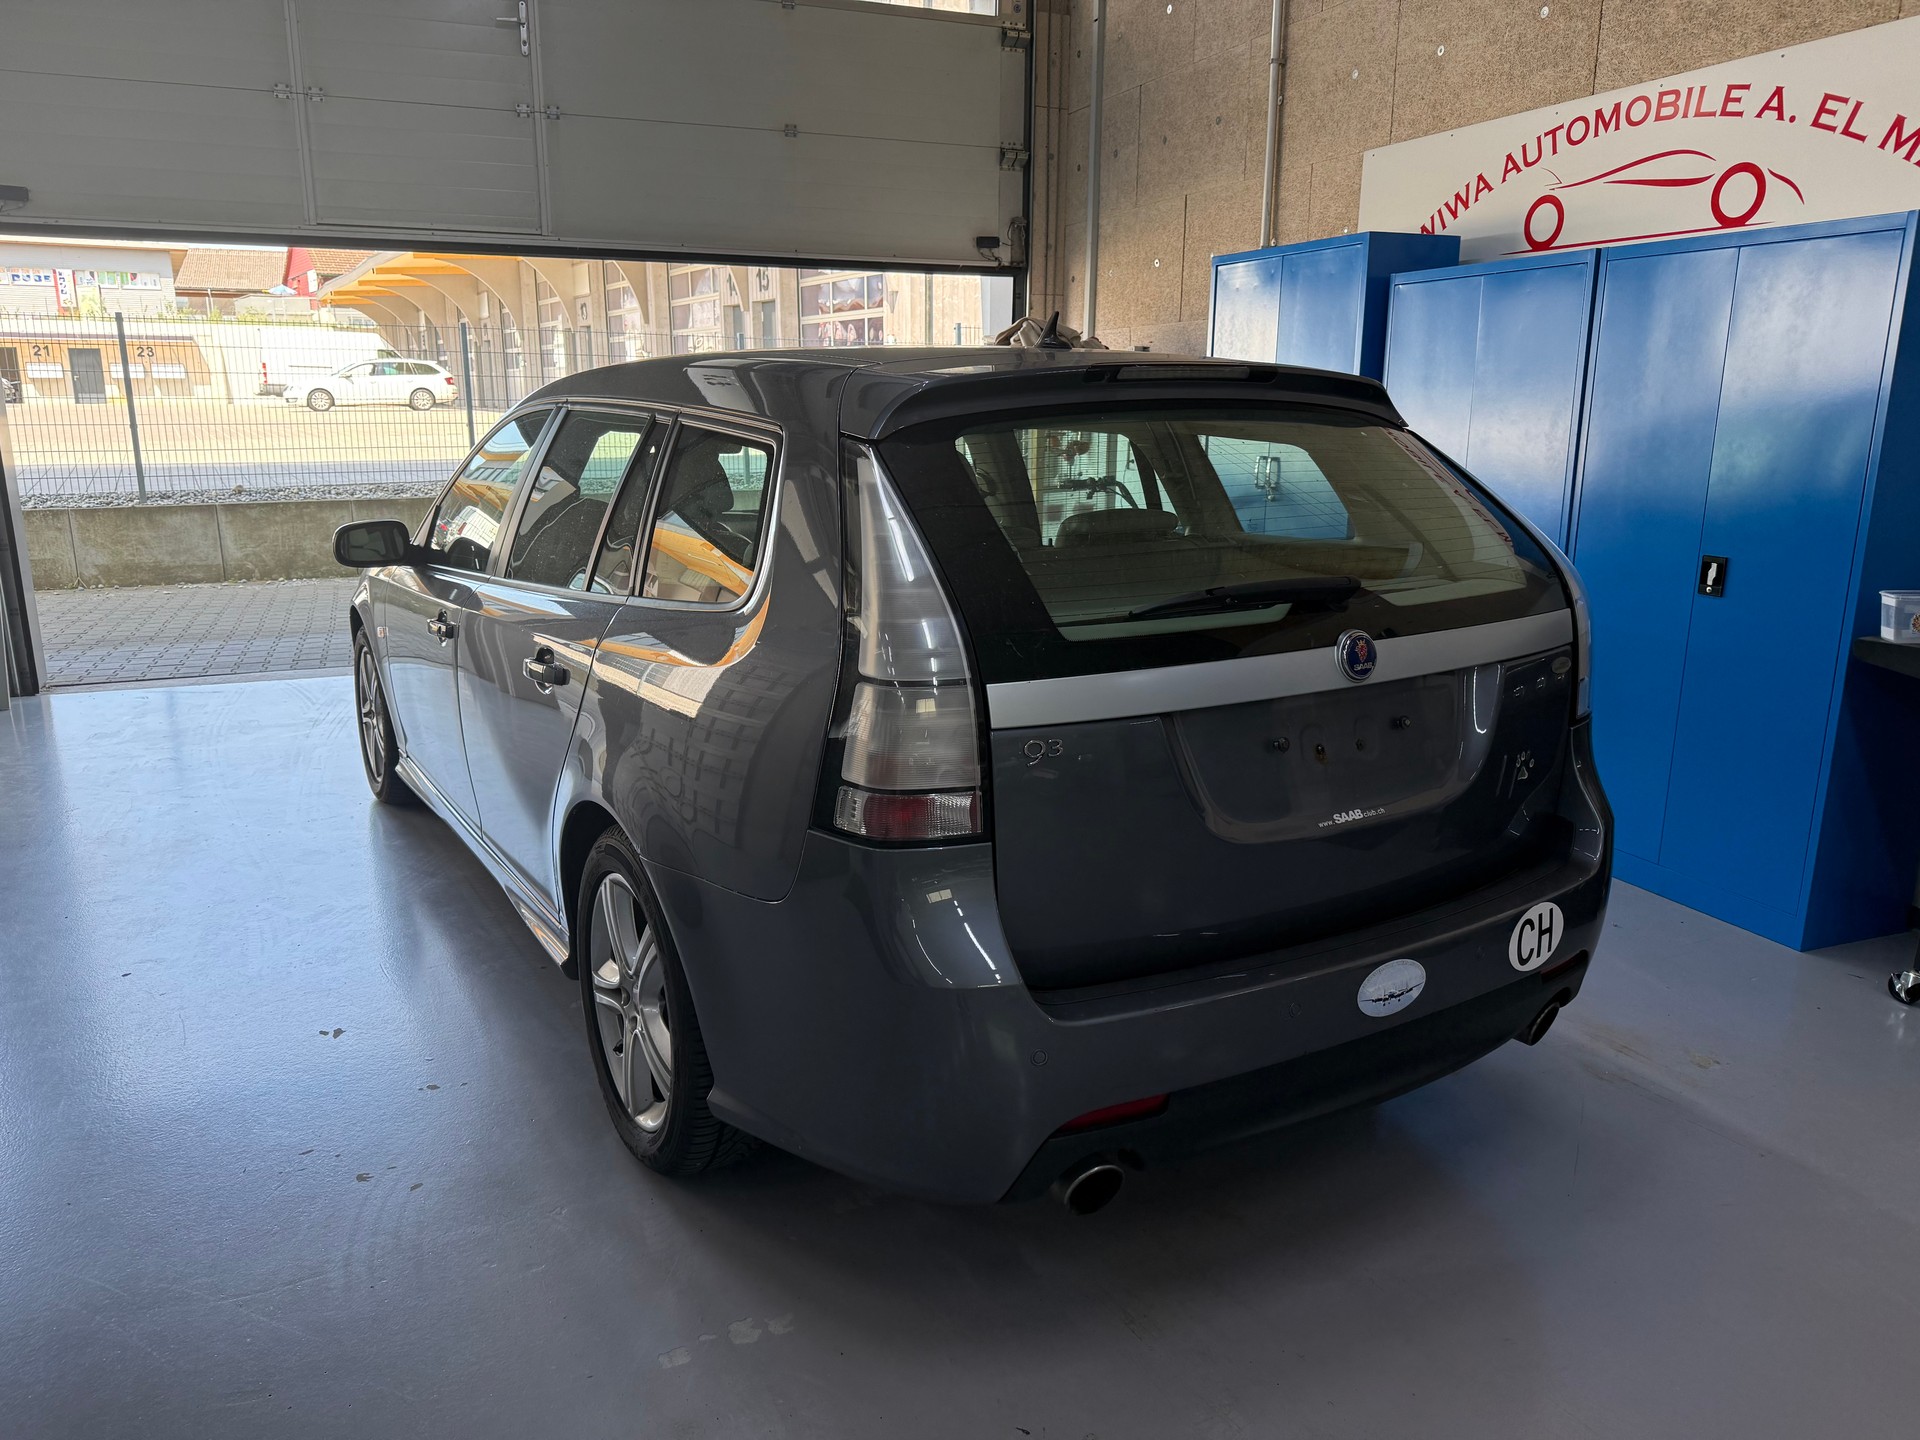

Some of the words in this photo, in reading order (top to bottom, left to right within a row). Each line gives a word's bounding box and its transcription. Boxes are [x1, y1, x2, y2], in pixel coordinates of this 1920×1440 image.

[1501, 83, 1752, 184] AUTOMOBILE
[1754, 86, 1797, 123] A.
[1809, 92, 1869, 143] EL
[1877, 113, 1920, 168] M
[32, 344, 51, 358] 21
[136, 346, 155, 358] 23
[1516, 907, 1554, 967] CH
